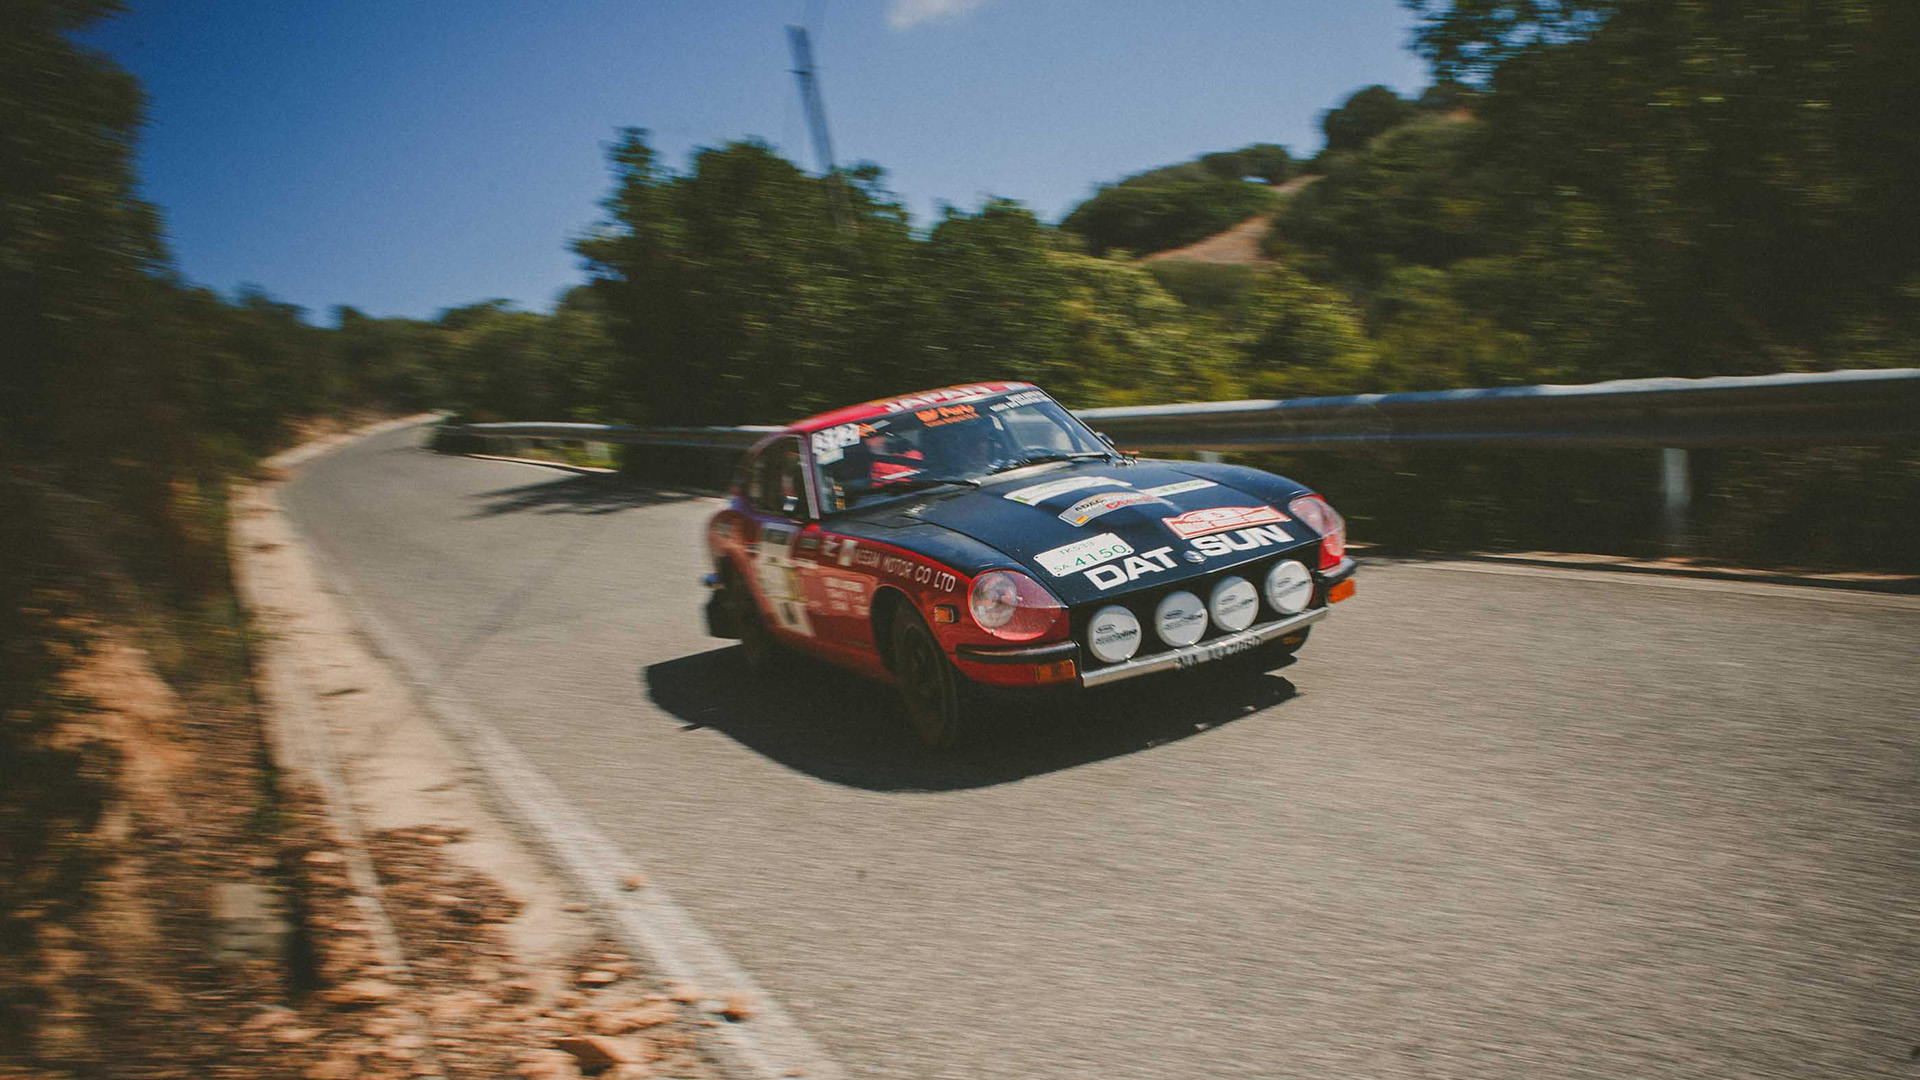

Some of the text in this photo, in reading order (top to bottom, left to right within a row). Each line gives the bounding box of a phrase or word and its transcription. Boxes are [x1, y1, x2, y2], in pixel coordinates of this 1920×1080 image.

[885, 387, 993, 413] JAPAN
[1075, 544, 1127, 566] 4150
[1083, 525, 1294, 590] DAT SUN
[915, 565, 931, 583] CO
[934, 571, 956, 592] LTD
